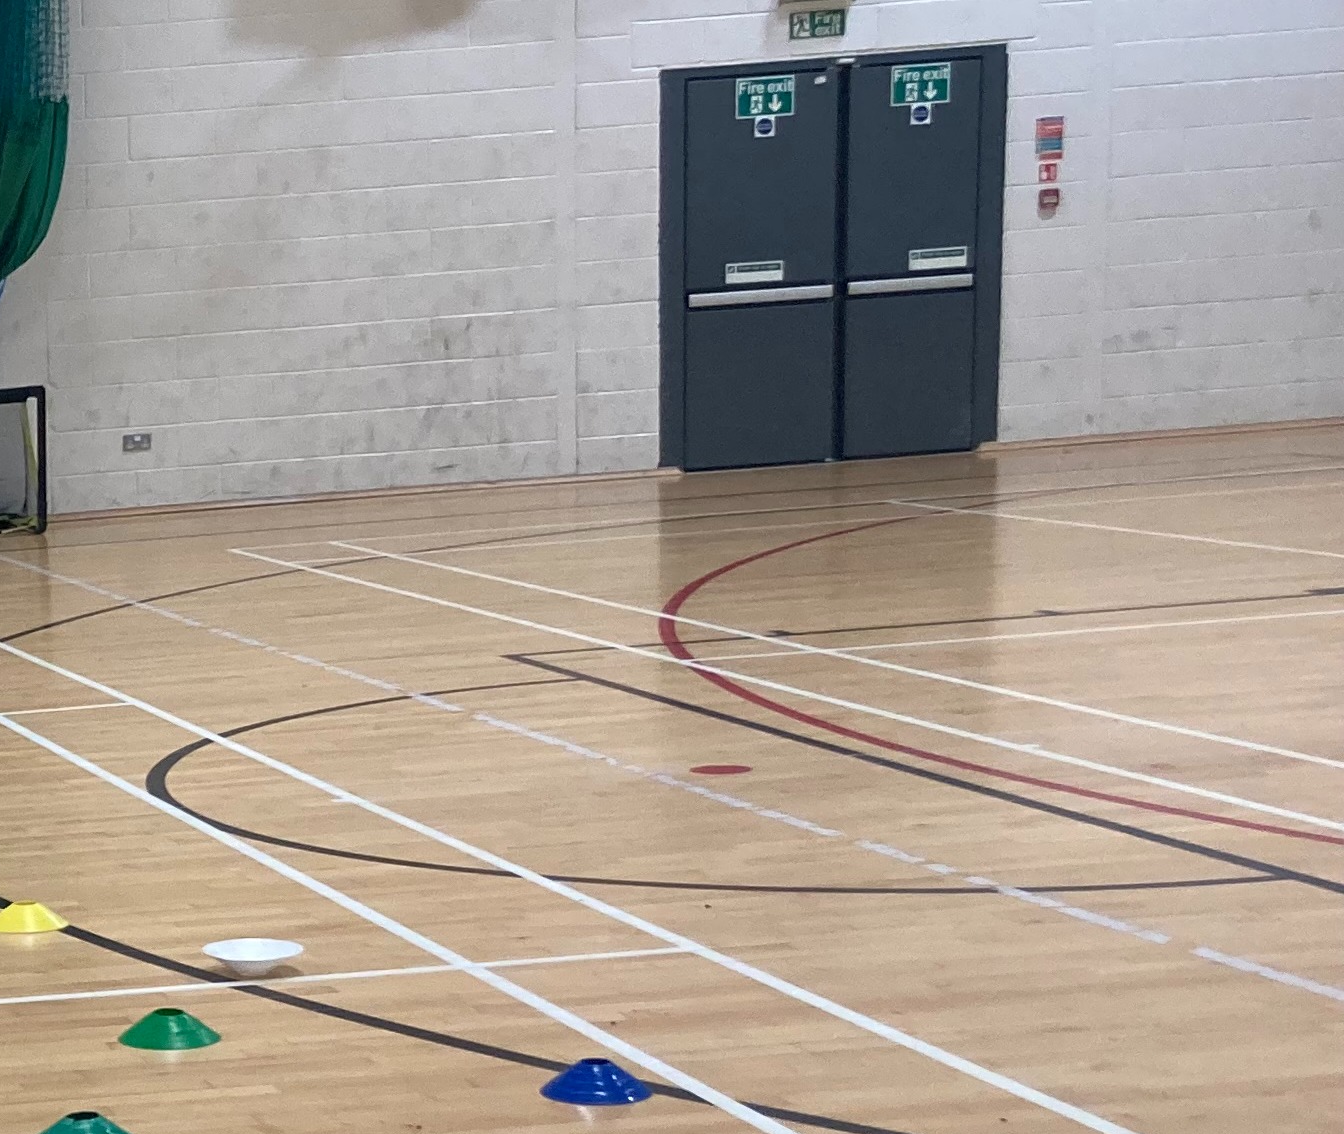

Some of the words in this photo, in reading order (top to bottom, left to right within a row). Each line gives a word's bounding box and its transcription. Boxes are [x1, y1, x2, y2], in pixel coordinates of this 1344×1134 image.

[894, 69, 920, 82] Fire
[923, 66, 950, 80] exit
[738, 82, 765, 95] Fire
[767, 79, 794, 93] exit
